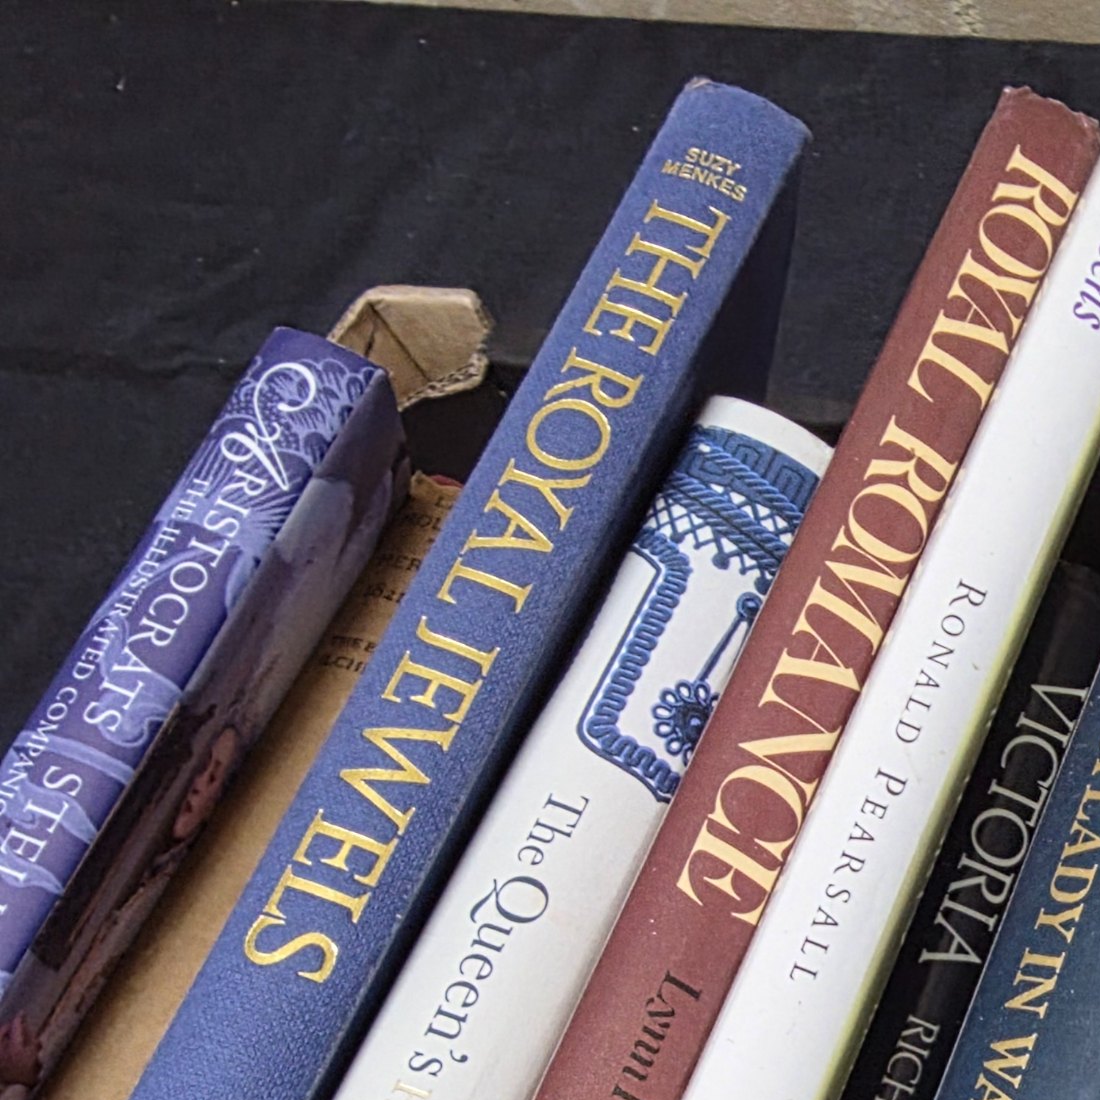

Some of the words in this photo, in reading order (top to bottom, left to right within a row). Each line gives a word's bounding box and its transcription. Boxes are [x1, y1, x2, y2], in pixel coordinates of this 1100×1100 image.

[661, 159, 748, 202] MENKES
[685, 147, 742, 176] SUZY
[584, 199, 732, 355] THE
[907, 145, 1078, 410] ROYAL
[82, 362, 318, 734] ARISTOCRATS
[170, 477, 211, 522] THE
[437, 347, 643, 612] ROYAL
[72, 524, 181, 680] ILLUSTRATED
[678, 415, 958, 926] ROMANCE
[895, 578, 988, 745] RONALD
[243, 615, 502, 983] JEWELS
[517, 793, 589, 866] The
[789, 768, 908, 981] PEARSALL
[917, 684, 1090, 966] VICTORIA
[623, 970, 704, 1083] Lynn
[1004, 948, 1066, 1019] IN
